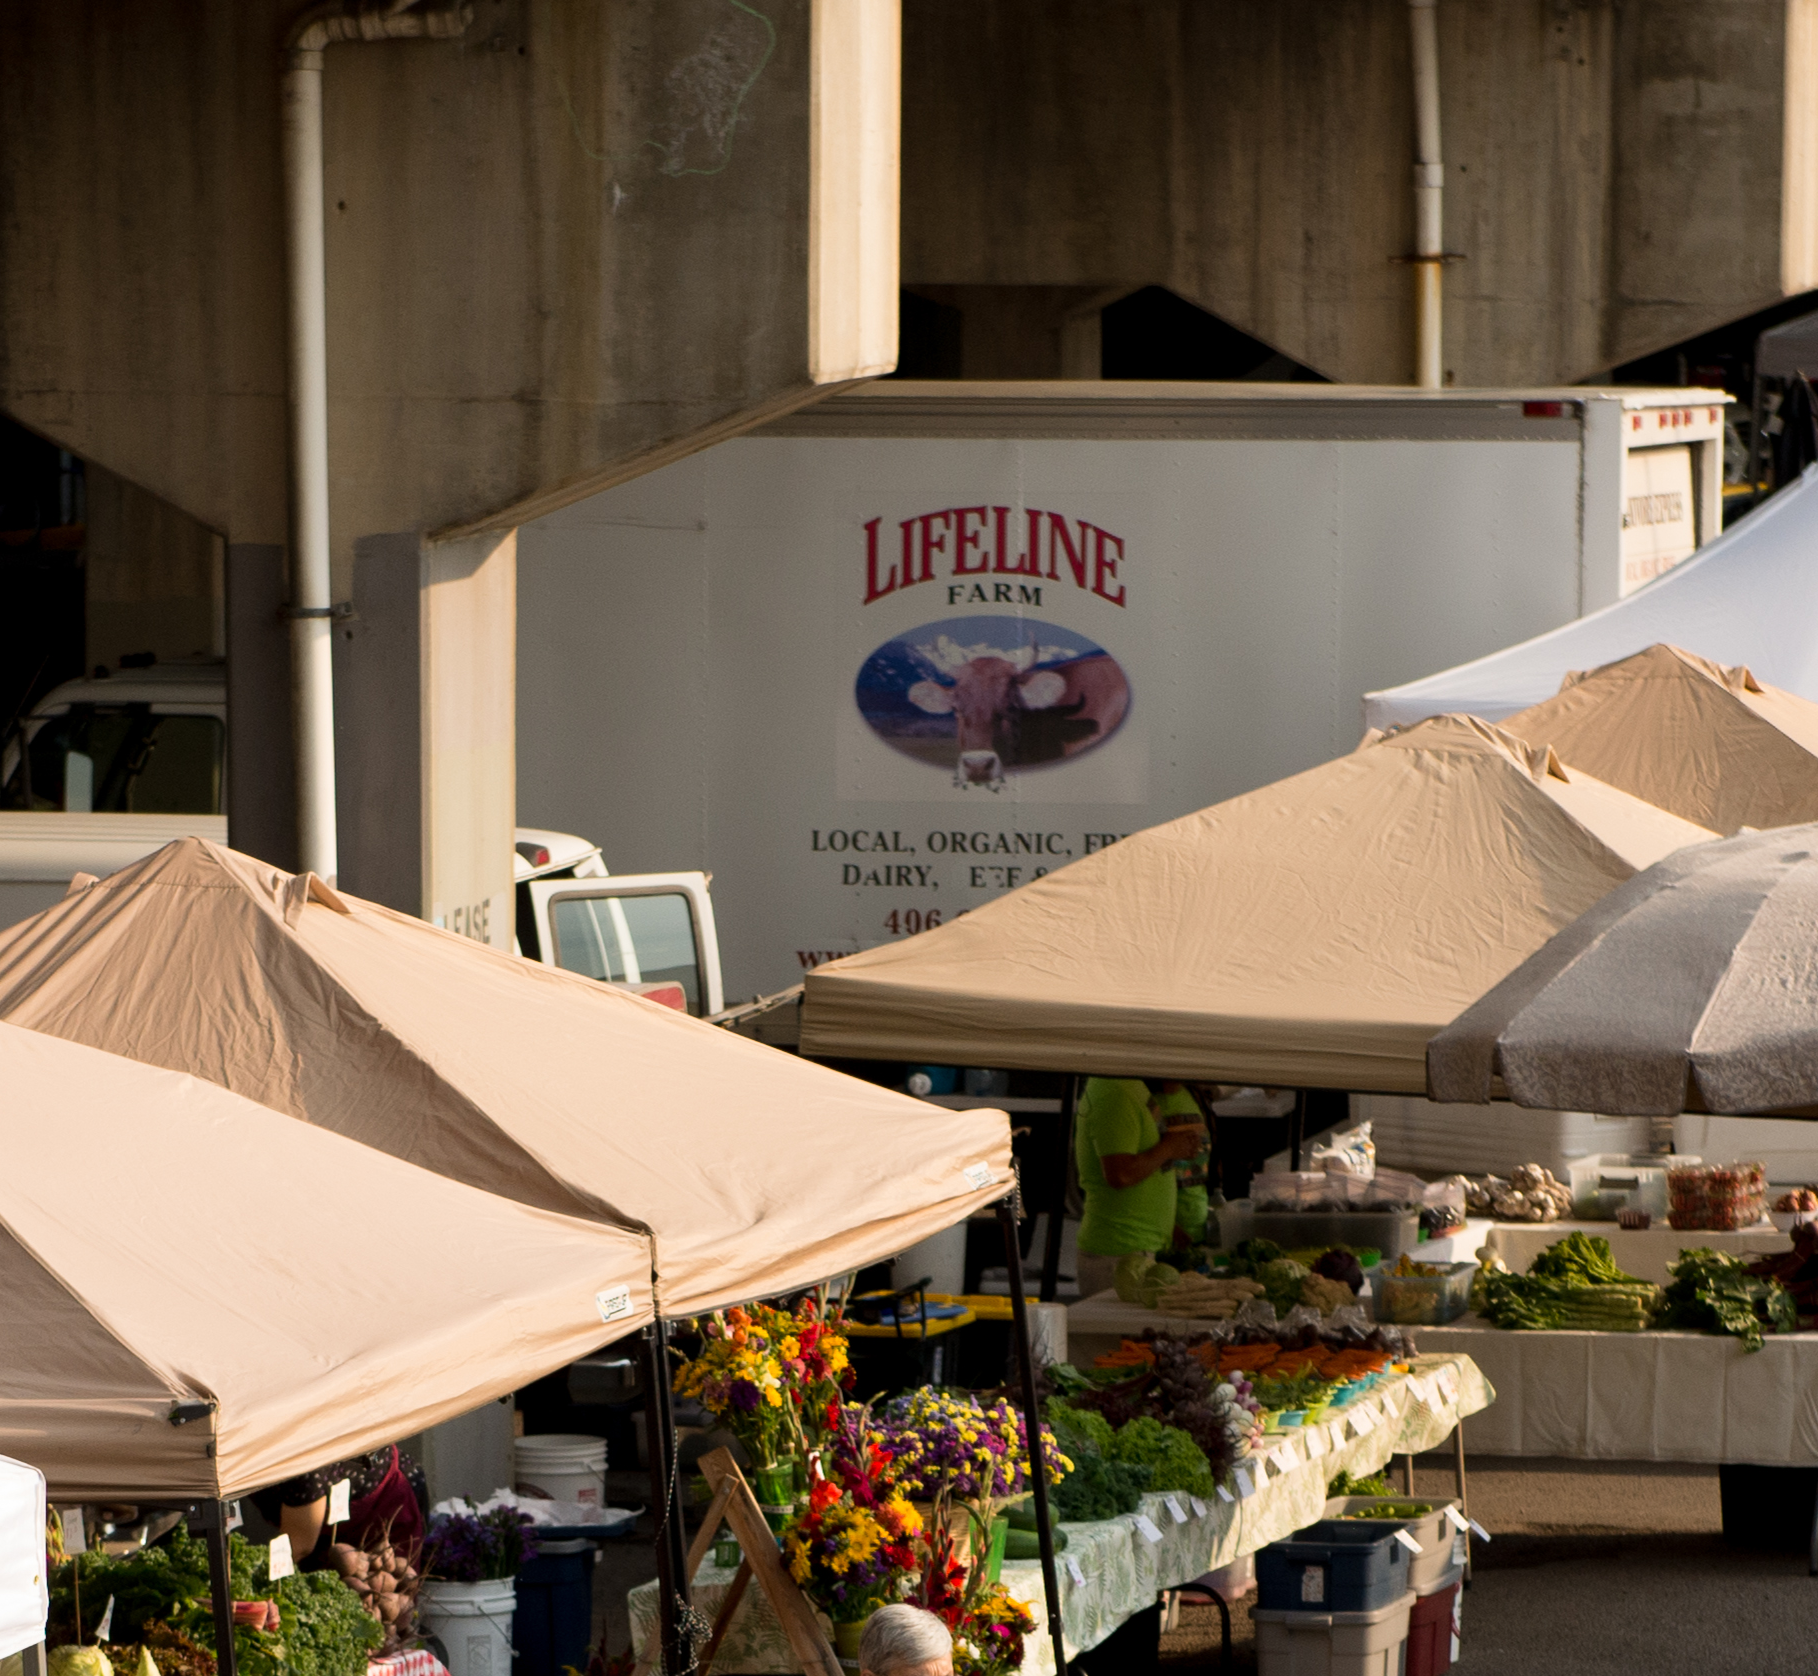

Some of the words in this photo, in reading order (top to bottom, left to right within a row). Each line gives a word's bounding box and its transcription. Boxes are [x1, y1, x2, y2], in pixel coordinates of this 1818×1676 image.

[863, 505, 1126, 609] LIFELINE
[948, 583, 1043, 607] FARM
[811, 829, 916, 857] LOCAL,
[927, 831, 1073, 858] ORGANIC,
[842, 864, 939, 890] DAIRY,
[883, 908, 942, 935] 406
